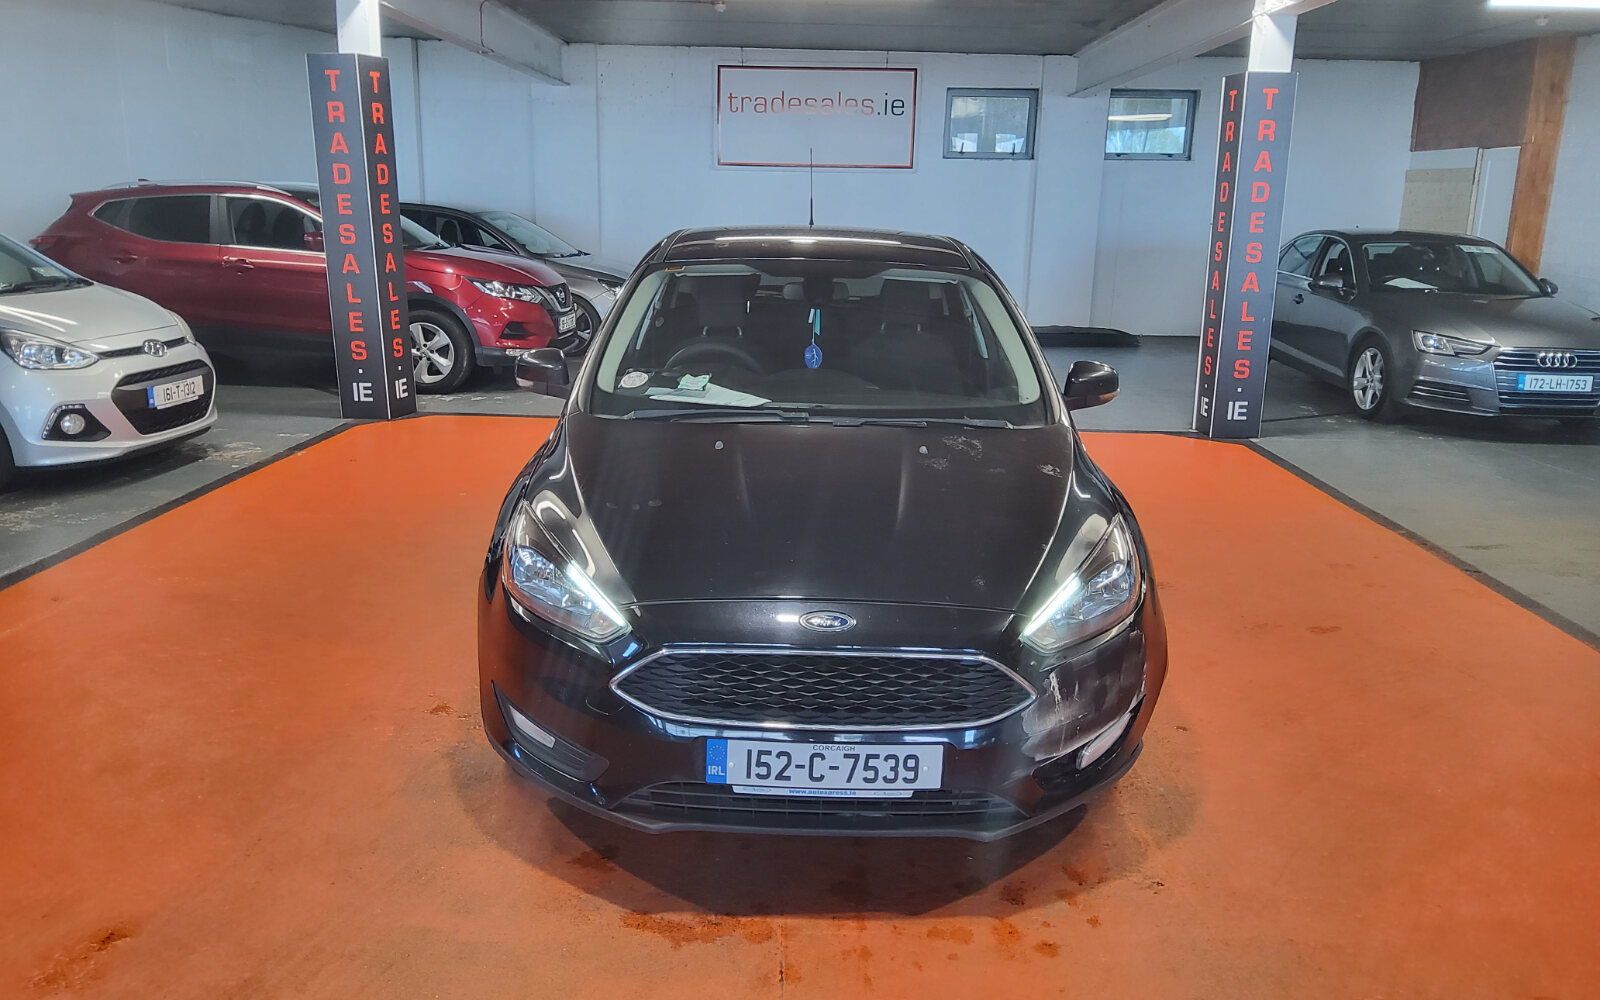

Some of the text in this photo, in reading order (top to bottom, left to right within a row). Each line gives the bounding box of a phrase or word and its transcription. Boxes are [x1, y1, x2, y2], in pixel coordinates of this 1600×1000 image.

[727, 90, 905, 116] tradesales.ie
[1529, 378, 1588, 391] 172-LH-1753
[812, 744, 856, 752] CORCAIGH
[707, 764, 726, 776] IRL
[745, 748, 920, 784] 152-C-7539
